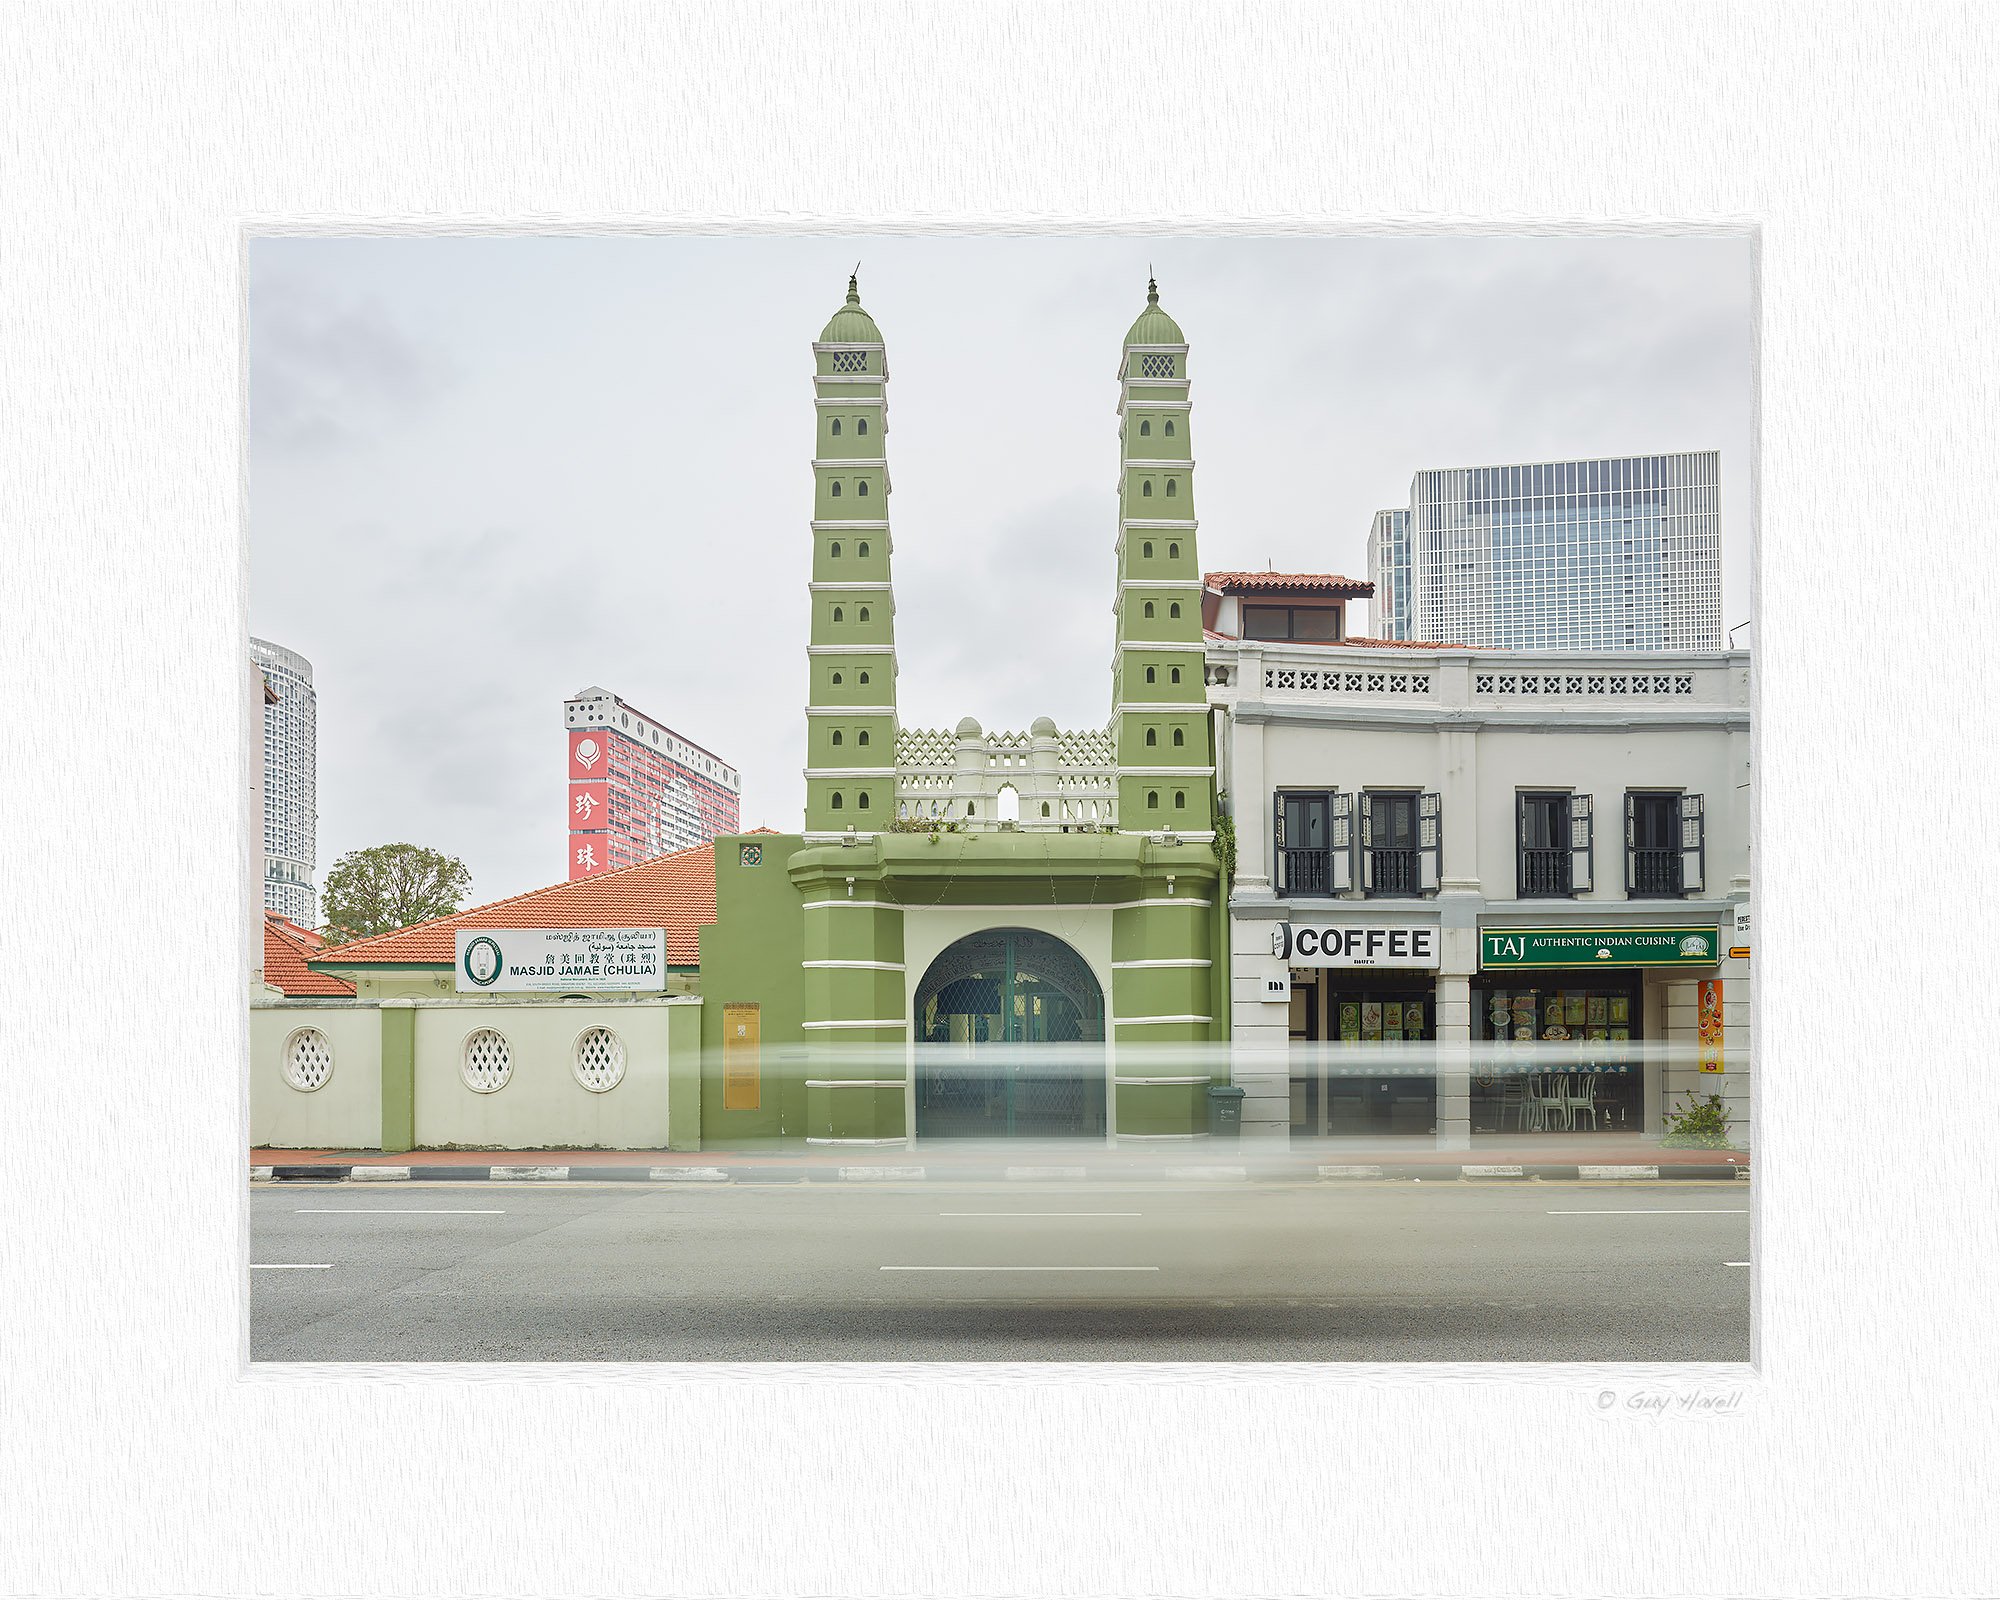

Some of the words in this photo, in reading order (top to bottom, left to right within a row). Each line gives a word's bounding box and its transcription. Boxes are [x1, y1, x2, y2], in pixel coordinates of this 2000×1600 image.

[575, 792, 600, 872] 珍珠
[1296, 928, 1431, 956] COFFEE
[1488, 937, 1526, 960] TAJ
[1532, 937, 1592, 947] AUTHENTIC
[1594, 937, 1632, 946] INDIAN
[1634, 936, 1676, 946] CUISINE
[510, 966, 555, 976] MASJID
[558, 966, 600, 976] JAMAE
[603, 964, 656, 976] (CHULIA)
